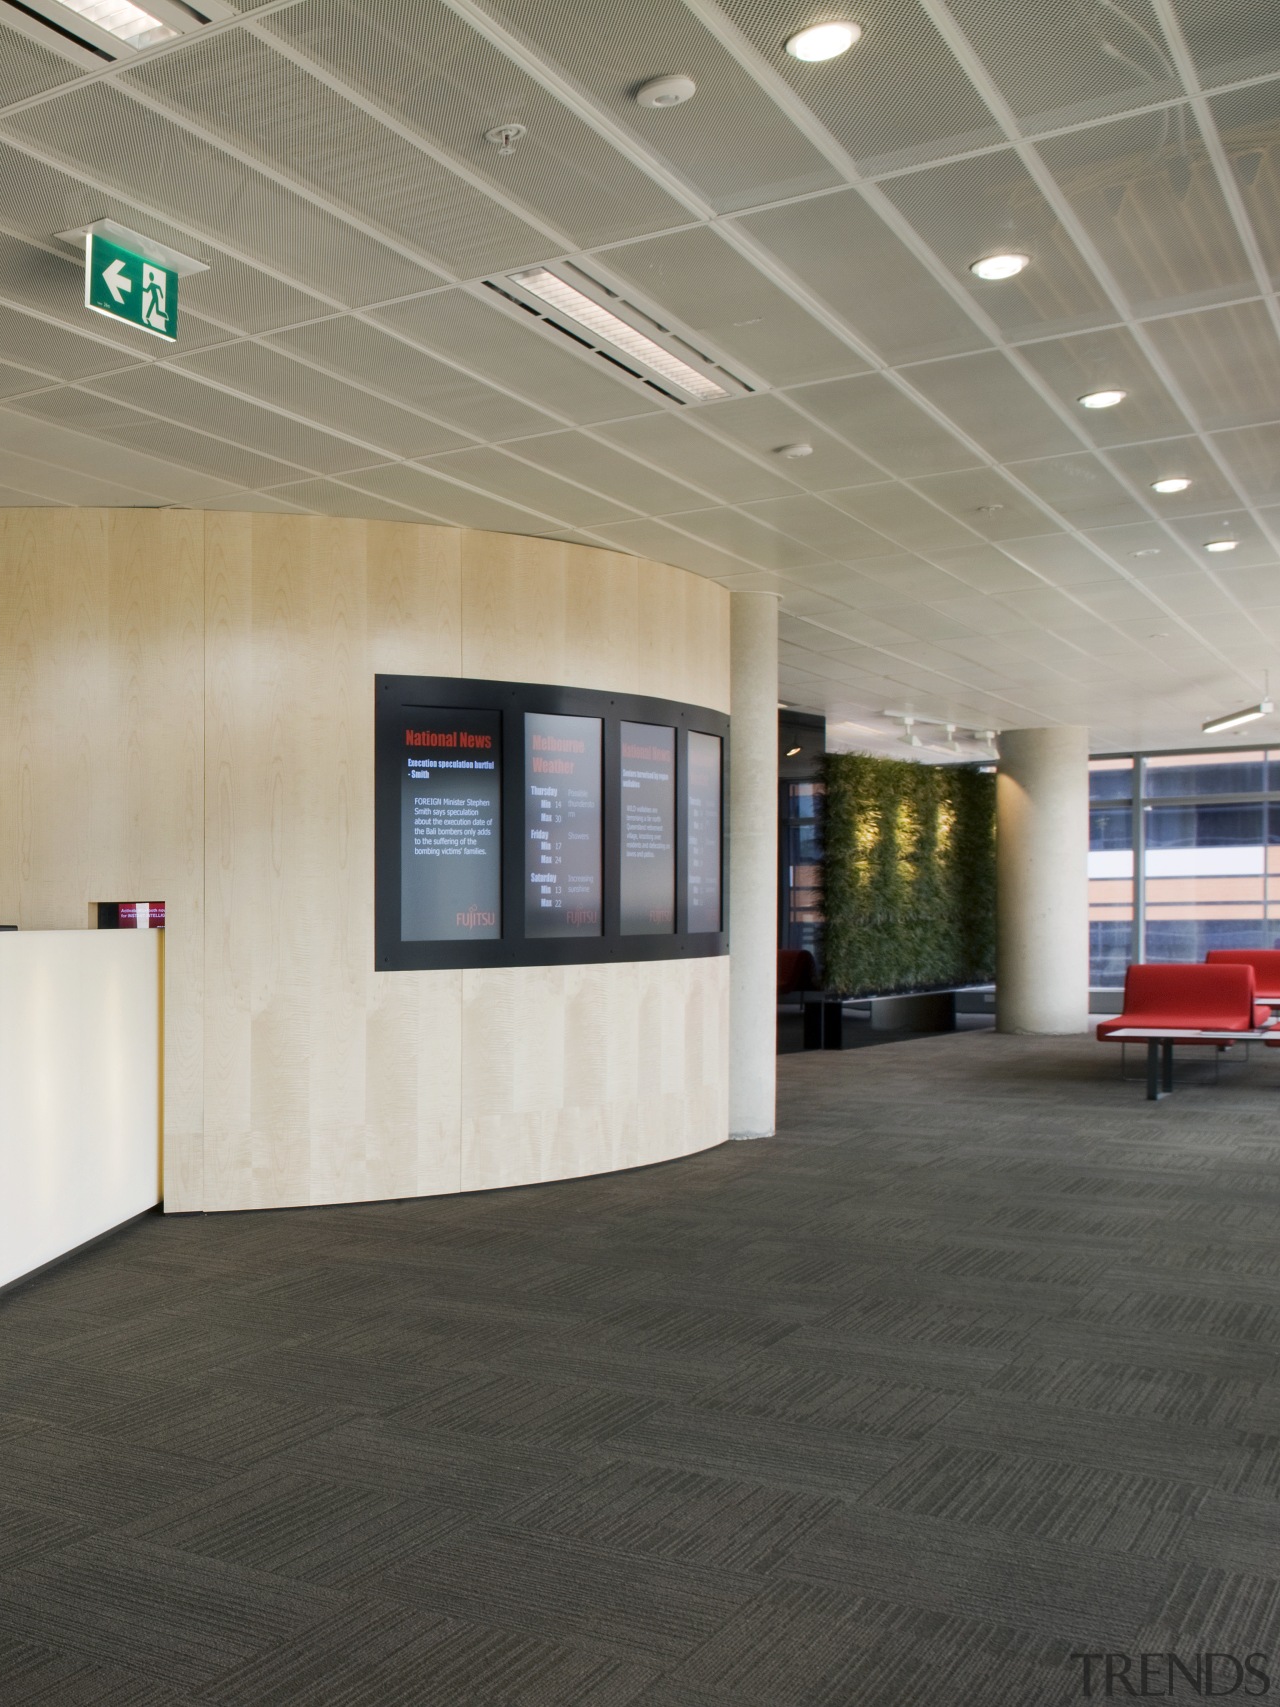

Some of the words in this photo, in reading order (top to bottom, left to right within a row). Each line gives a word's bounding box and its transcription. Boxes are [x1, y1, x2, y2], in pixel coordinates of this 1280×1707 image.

[405, 730, 457, 747] National
[459, 732, 492, 748] News
[407, 758, 438, 768] Execution
[438, 760, 474, 769] speculation
[532, 757, 574, 774] Weather
[411, 769, 430, 779] Smith
[531, 785, 558, 797] Thursday
[414, 797, 442, 806] FOREIGN
[443, 798, 465, 806] Minister
[466, 798, 490, 807] Stephen
[540, 800, 551, 809] Min
[414, 807, 432, 815] Smith
[446, 809, 479, 817] speculation
[414, 817, 432, 825] about
[443, 818, 471, 826] execution
[472, 818, 486, 826] date
[486, 818, 493, 826] of
[540, 813, 552, 822] Max
[425, 827, 437, 835] Bali
[437, 828, 463, 836] bombers
[463, 828, 476, 837] only
[476, 828, 491, 836] adds
[530, 829, 549, 840] Friday
[414, 837, 422, 845] to
[422, 837, 433, 845] the
[433, 837, 459, 847] suffering
[459, 837, 466, 845] of
[466, 837, 477, 845] the
[540, 841, 552, 850] Min
[414, 847, 440, 857] bombing
[441, 847, 463, 855] victims'
[463, 847, 487, 855] families.
[540, 854, 552, 864] Max
[530, 872, 557, 883] Saturday
[540, 885, 552, 894] Min
[540, 898, 552, 907] Max
[456, 908, 495, 928] FUJITSU
